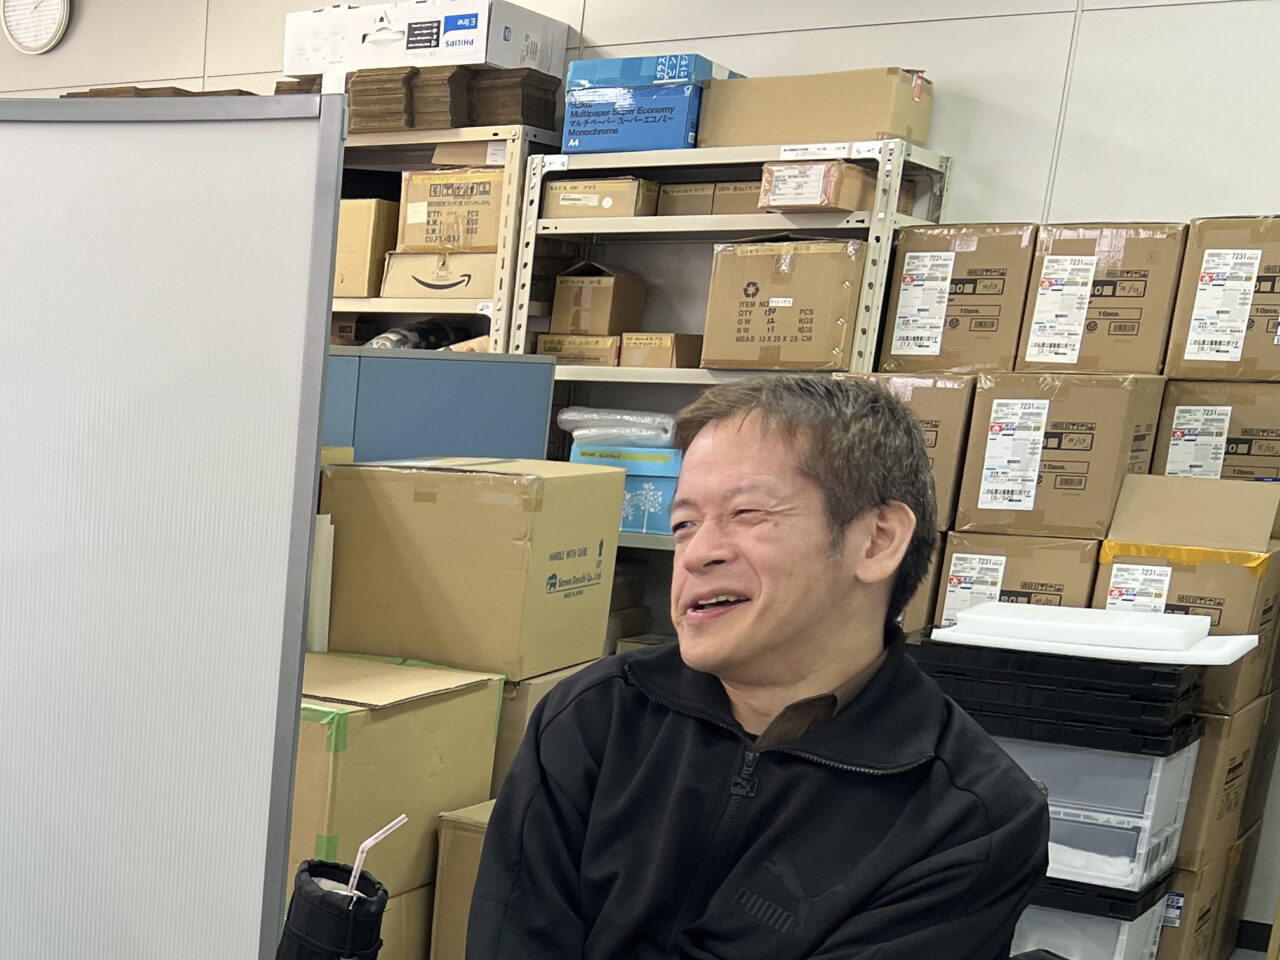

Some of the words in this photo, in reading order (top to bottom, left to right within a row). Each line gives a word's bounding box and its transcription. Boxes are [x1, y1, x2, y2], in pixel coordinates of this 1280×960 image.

[457, 18, 470, 26] line
[445, 38, 474, 47] PHILIPS
[570, 110, 610, 118] Multipaper
[637, 106, 675, 115] Economy
[570, 118, 615, 127] マルチペーパー
[568, 128, 619, 136] Monochrome
[568, 139, 579, 147] A4
[929, 254, 942, 262] 7231
[799, 308, 814, 316] PCS
[798, 317, 814, 325] KGS
[797, 326, 813, 334] KGS
[736, 335, 755, 343] MEAS
[1020, 402, 1034, 410] 7231
[566, 548, 577, 559] WITH
[978, 557, 992, 566] 7231
[1141, 568, 1156, 576] 7231
[558, 577, 573, 588] Sanwa
[573, 573, 587, 585] Denshi
[731, 887, 796, 933] PUMA
